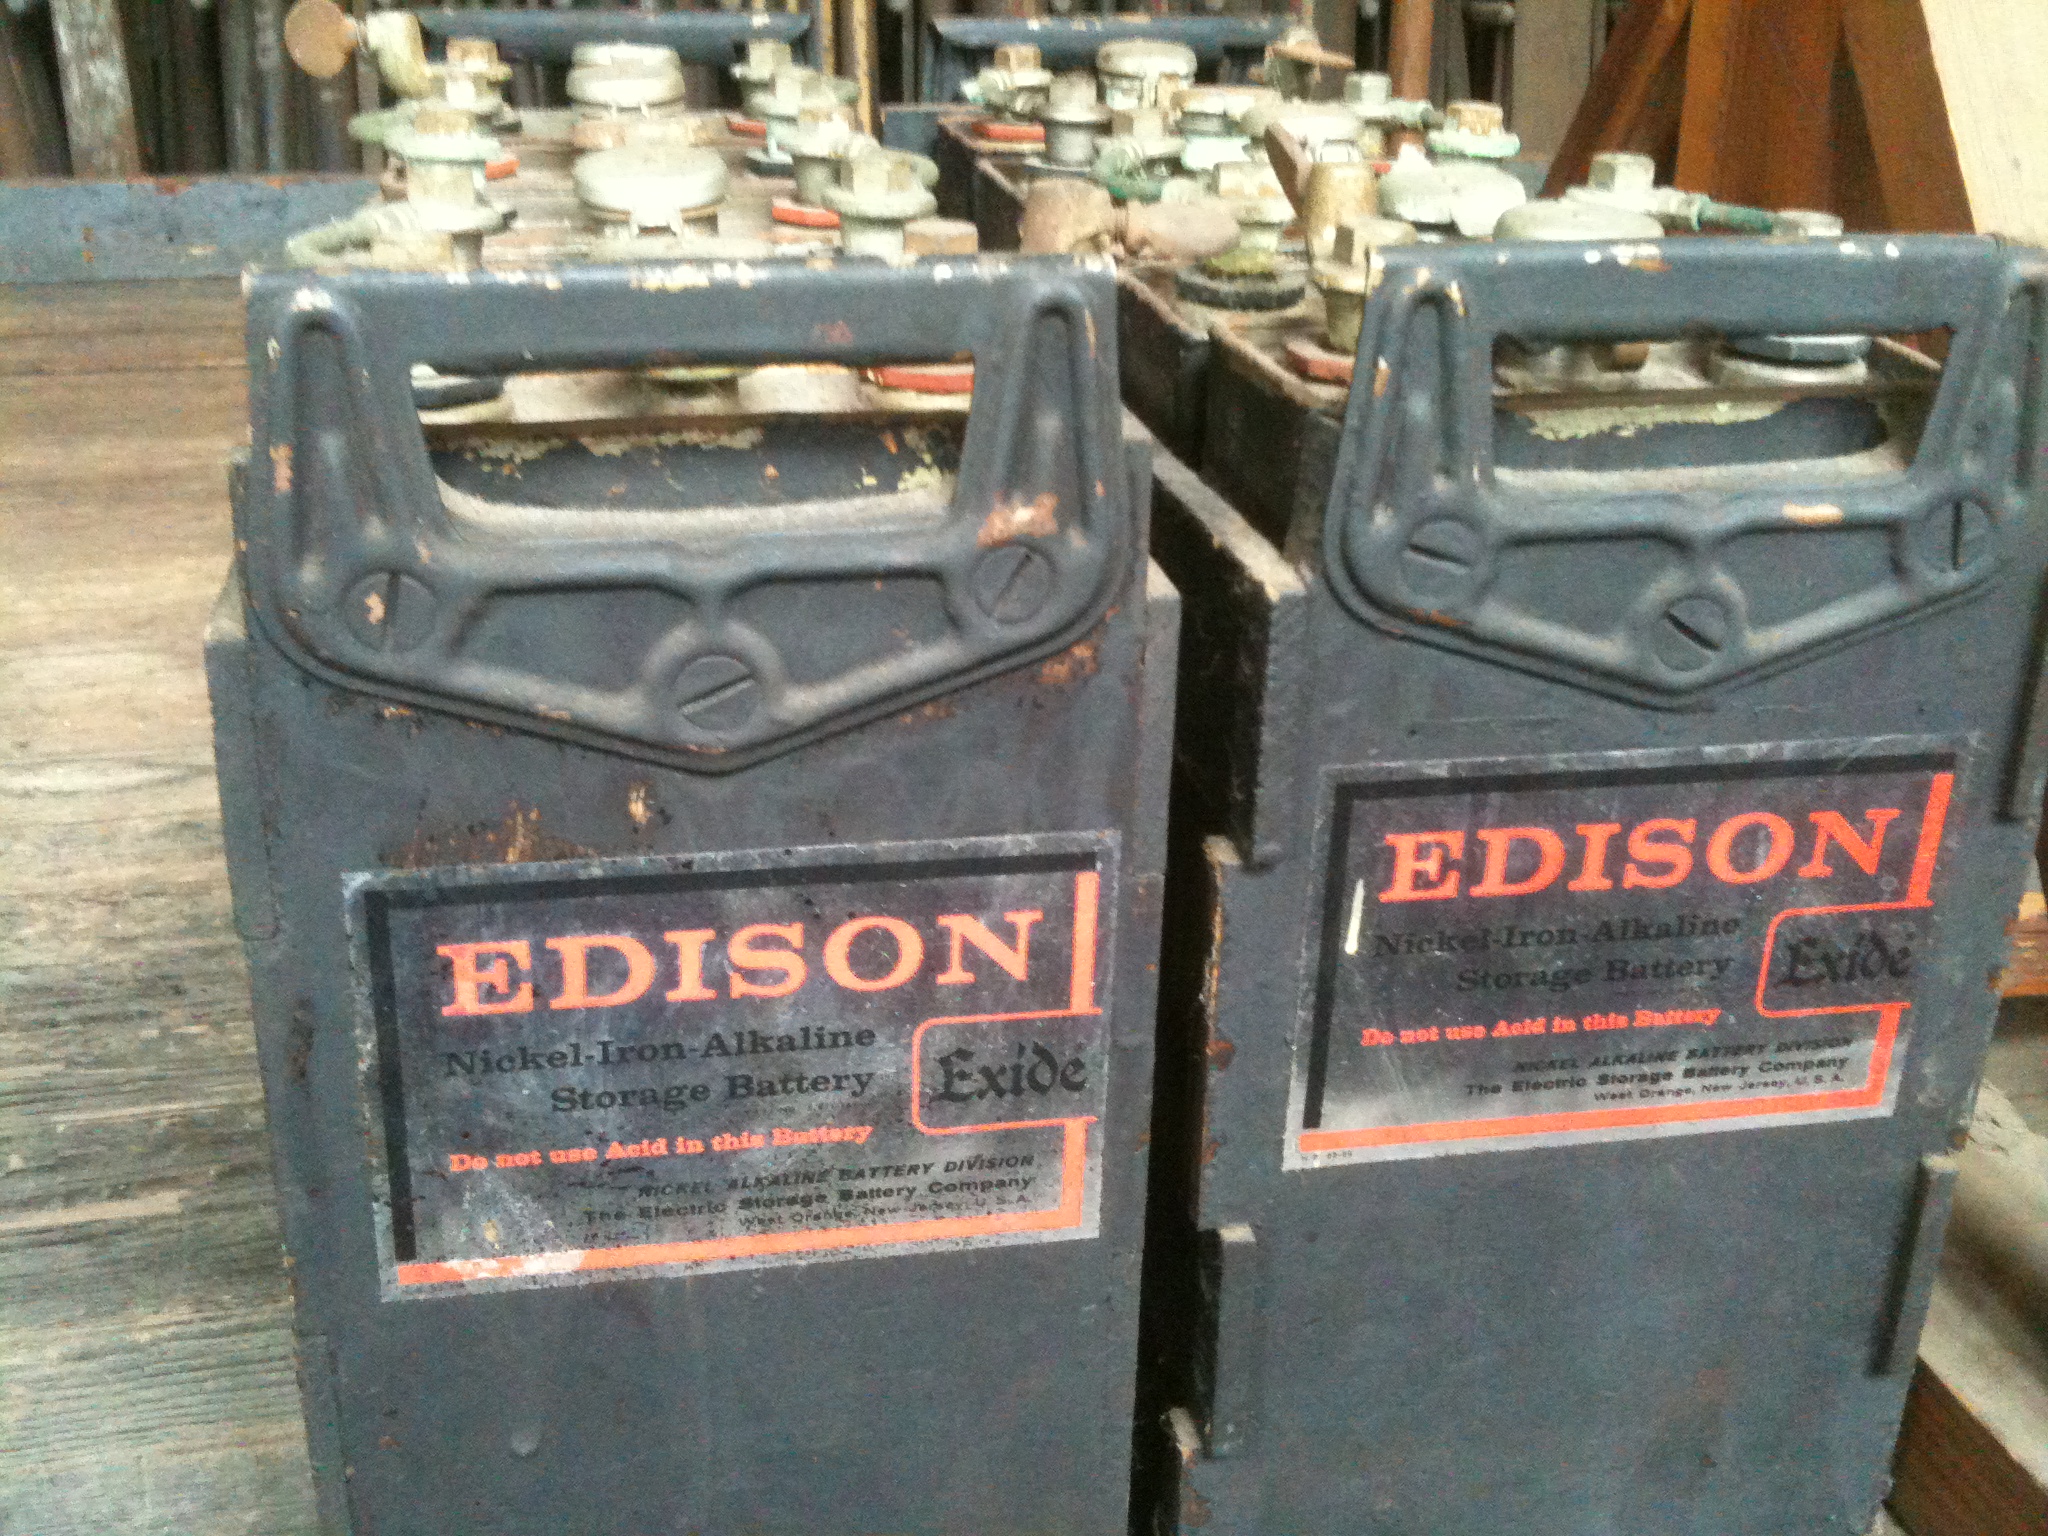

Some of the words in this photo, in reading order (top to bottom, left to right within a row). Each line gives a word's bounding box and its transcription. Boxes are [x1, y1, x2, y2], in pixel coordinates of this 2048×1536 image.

[1378, 808, 1903, 903] EDISON
[1374, 916, 1741, 957] Nickel-Iron-Alkaline
[437, 910, 1044, 1017] EDISON
[1456, 965, 1592, 993] Storage
[1603, 957, 1734, 982] Battery
[1772, 930, 1915, 988] Exide
[1361, 1028, 1394, 1046] Do
[1400, 1026, 1439, 1044] not
[1445, 1024, 1487, 1041] use
[1492, 1018, 1547, 1038] Acid
[1552, 1016, 1577, 1034] in
[1583, 1012, 1629, 1032] this
[1634, 1009, 1722, 1027] Battery
[446, 1026, 877, 1077] Nickel-Iron-Alkaline
[930, 1040, 1089, 1103] Exide
[551, 1083, 710, 1112] Storage
[726, 1070, 876, 1099] Battery
[1465, 1083, 1502, 1096] The
[1598, 1070, 1673, 1087] Storage
[1758, 1057, 1849, 1073] Company
[450, 1154, 488, 1171] Do
[496, 1151, 542, 1168] not
[549, 1148, 597, 1164] use
[605, 1138, 668, 1160] Acid
[676, 1137, 705, 1154] in
[711, 1131, 765, 1151] this
[772, 1125, 874, 1146] Battery
[838, 1162, 935, 1182] BATTERY
[943, 1154, 1035, 1173] DIVISION
[838, 1184, 918, 1201] Battery
[928, 1176, 1036, 1193] Company
